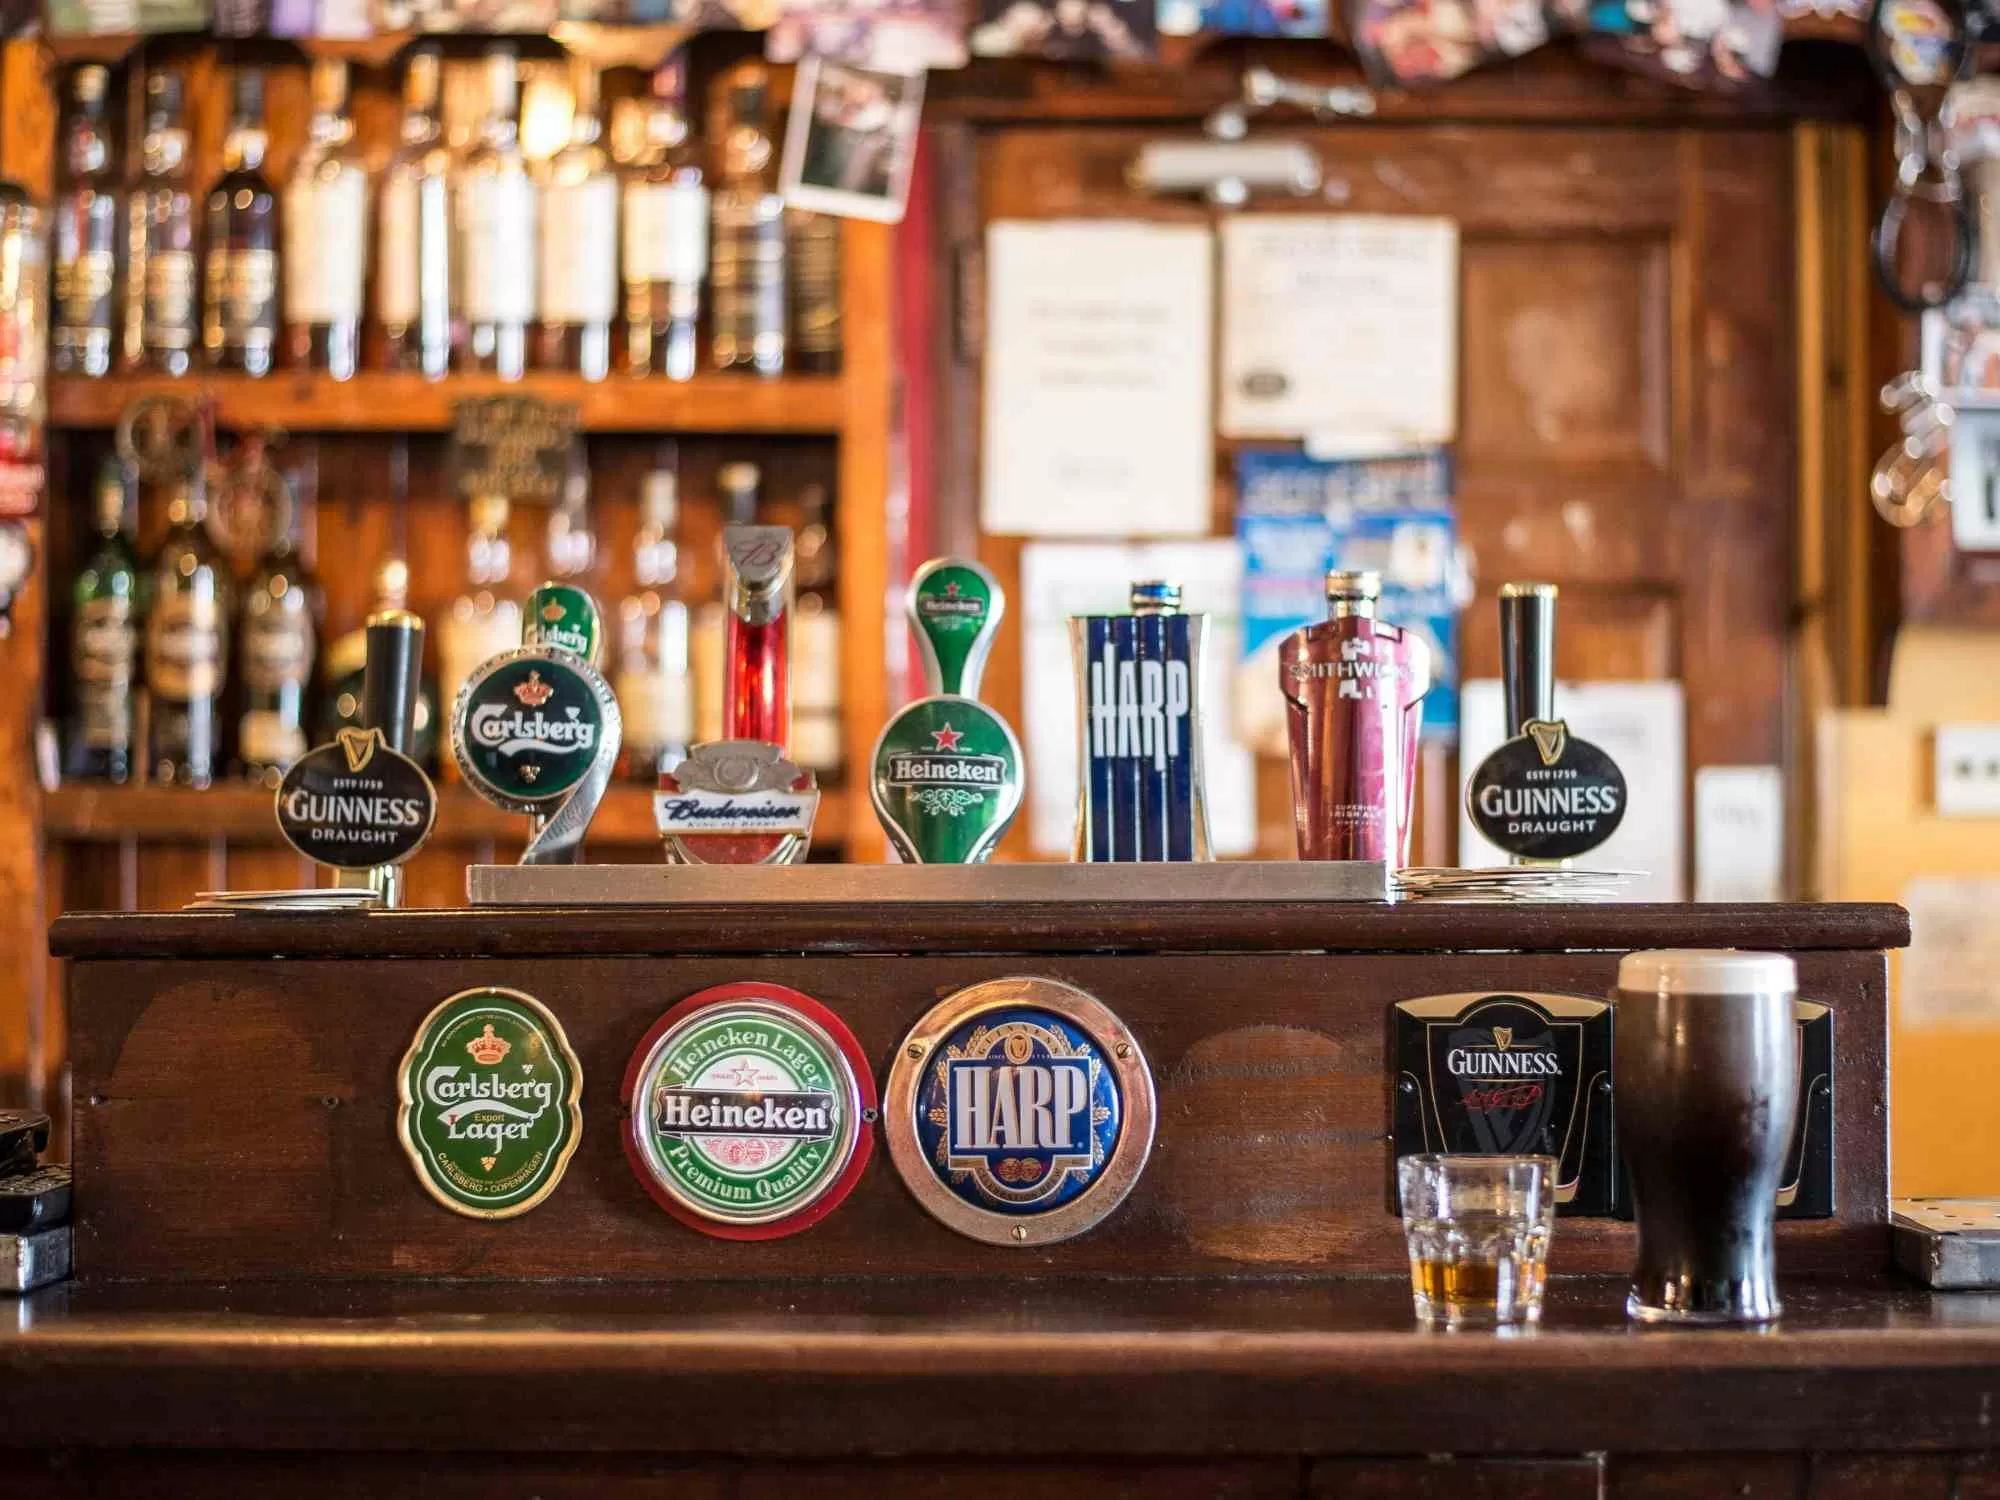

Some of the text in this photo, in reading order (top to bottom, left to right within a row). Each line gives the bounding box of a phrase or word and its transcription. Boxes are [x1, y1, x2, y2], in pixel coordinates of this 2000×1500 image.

[524, 624, 588, 653] Clsberg
[1091, 641, 1190, 772] HARP
[470, 703, 595, 752] Carlsberg
[895, 760, 999, 781] Heineken
[287, 789, 421, 827] GUINNESS
[664, 799, 801, 821] Budweiser
[1479, 784, 1617, 817] GUINNESS
[311, 828, 398, 844] DRAUGHT
[1508, 819, 1597, 834] DRAUGHT
[671, 1027, 823, 1089] Heineken Lager
[1447, 1048, 1559, 1075] GUINNESS
[425, 1065, 553, 1112] Carlsberg
[474, 1113, 505, 1123] Export
[664, 1096, 829, 1130] Heineken
[952, 1066, 1088, 1149] HARP
[447, 1119, 535, 1154] Lager
[438, 1152, 483, 1193] CARLSBERG
[670, 1145, 823, 1200] Premium Quality
